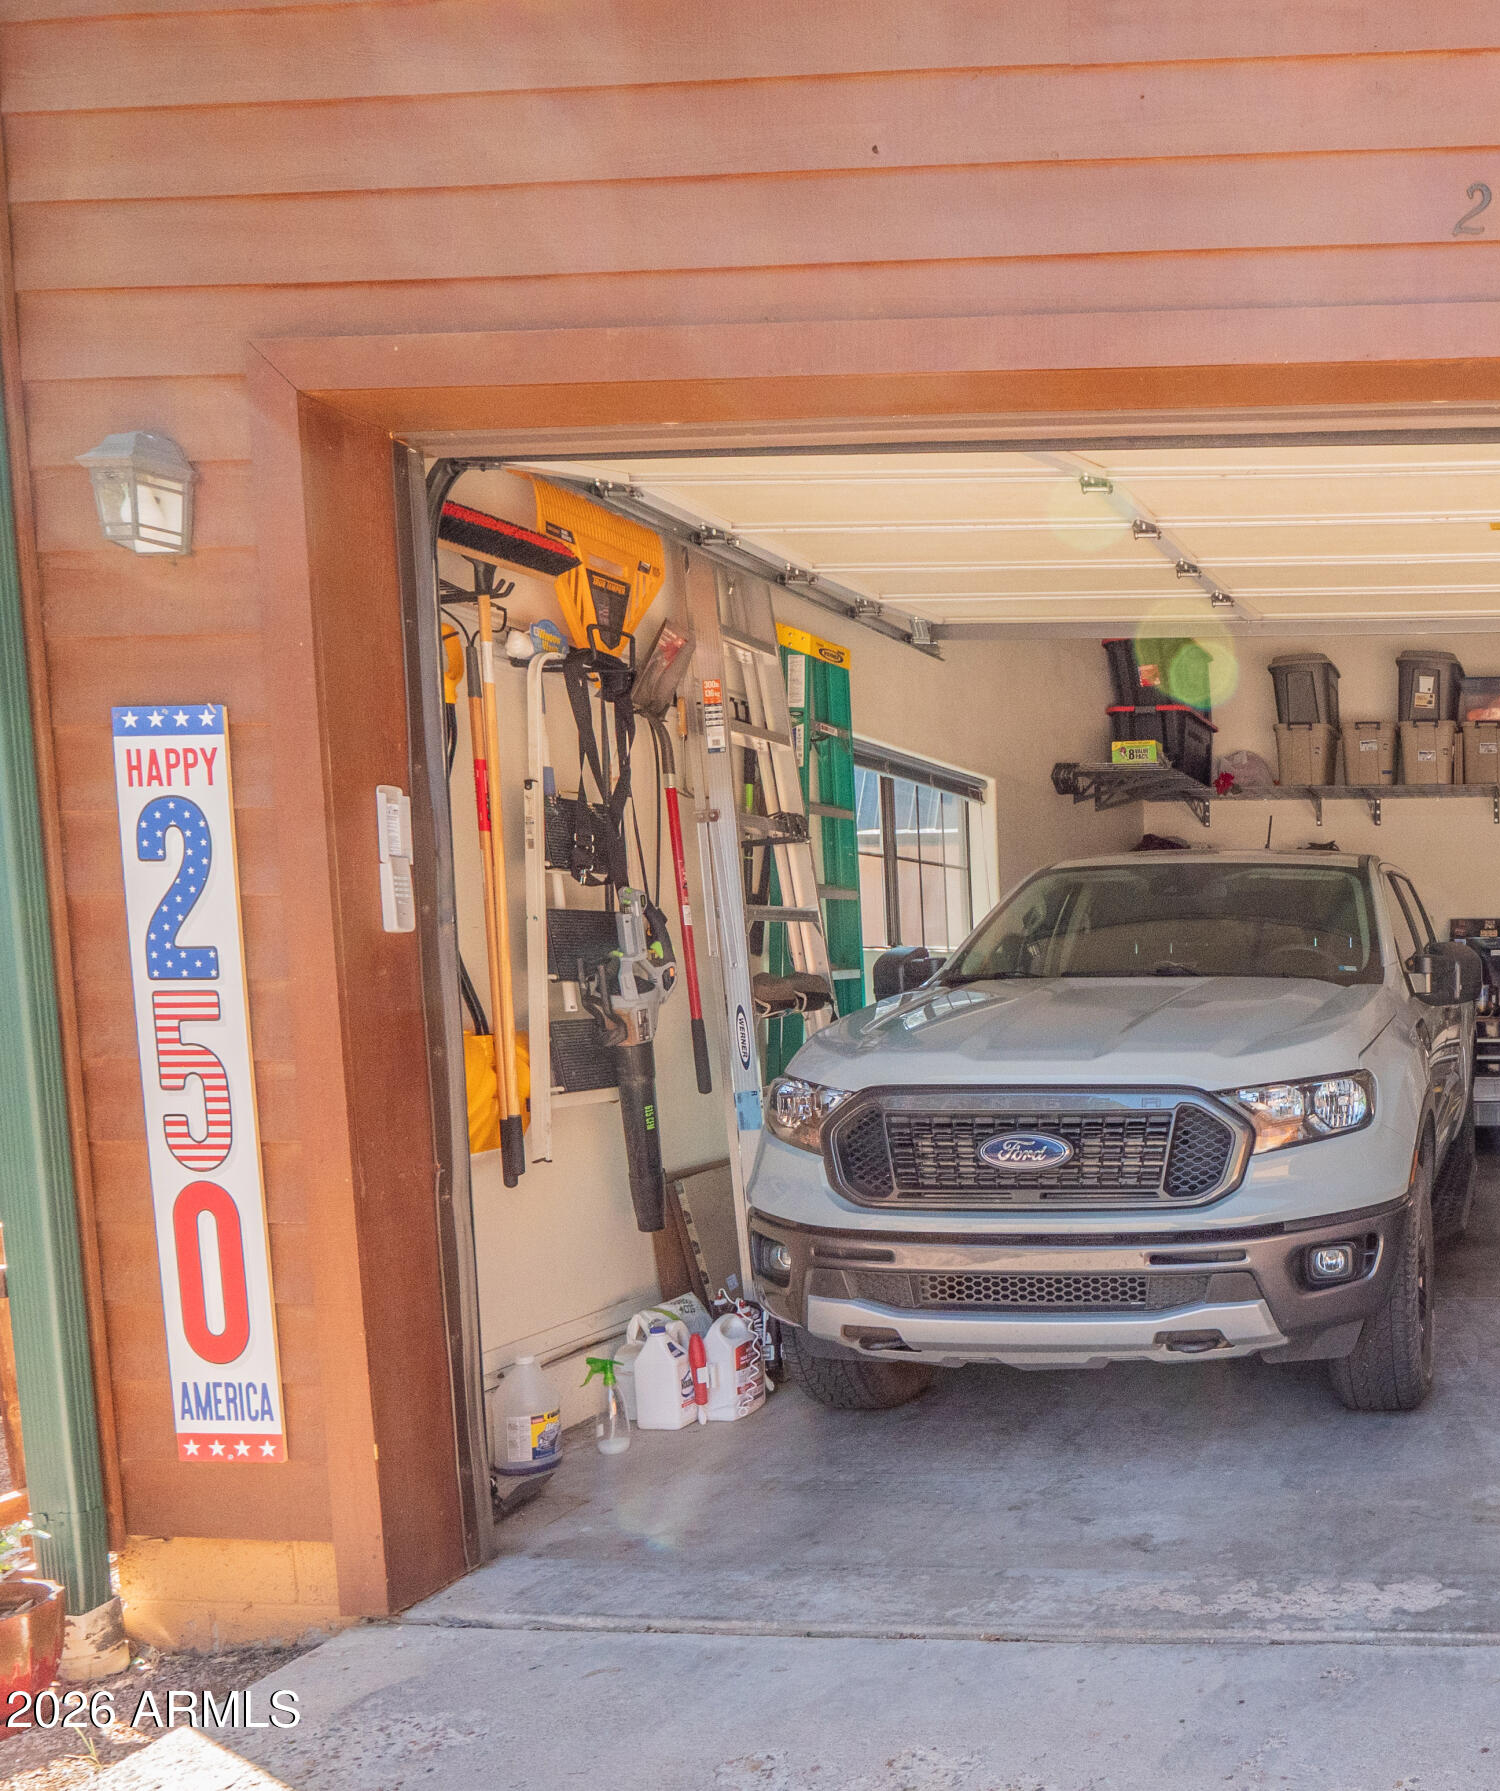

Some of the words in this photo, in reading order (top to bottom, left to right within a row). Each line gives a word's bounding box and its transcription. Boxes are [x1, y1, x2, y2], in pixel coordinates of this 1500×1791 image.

[126, 747, 217, 787] HAPPY
[1128, 749, 1135, 760] 8
[738, 1017, 748, 1059] WERNER
[997, 1139, 1048, 1161] Ford
[180, 1380, 275, 1423] AMERICA
